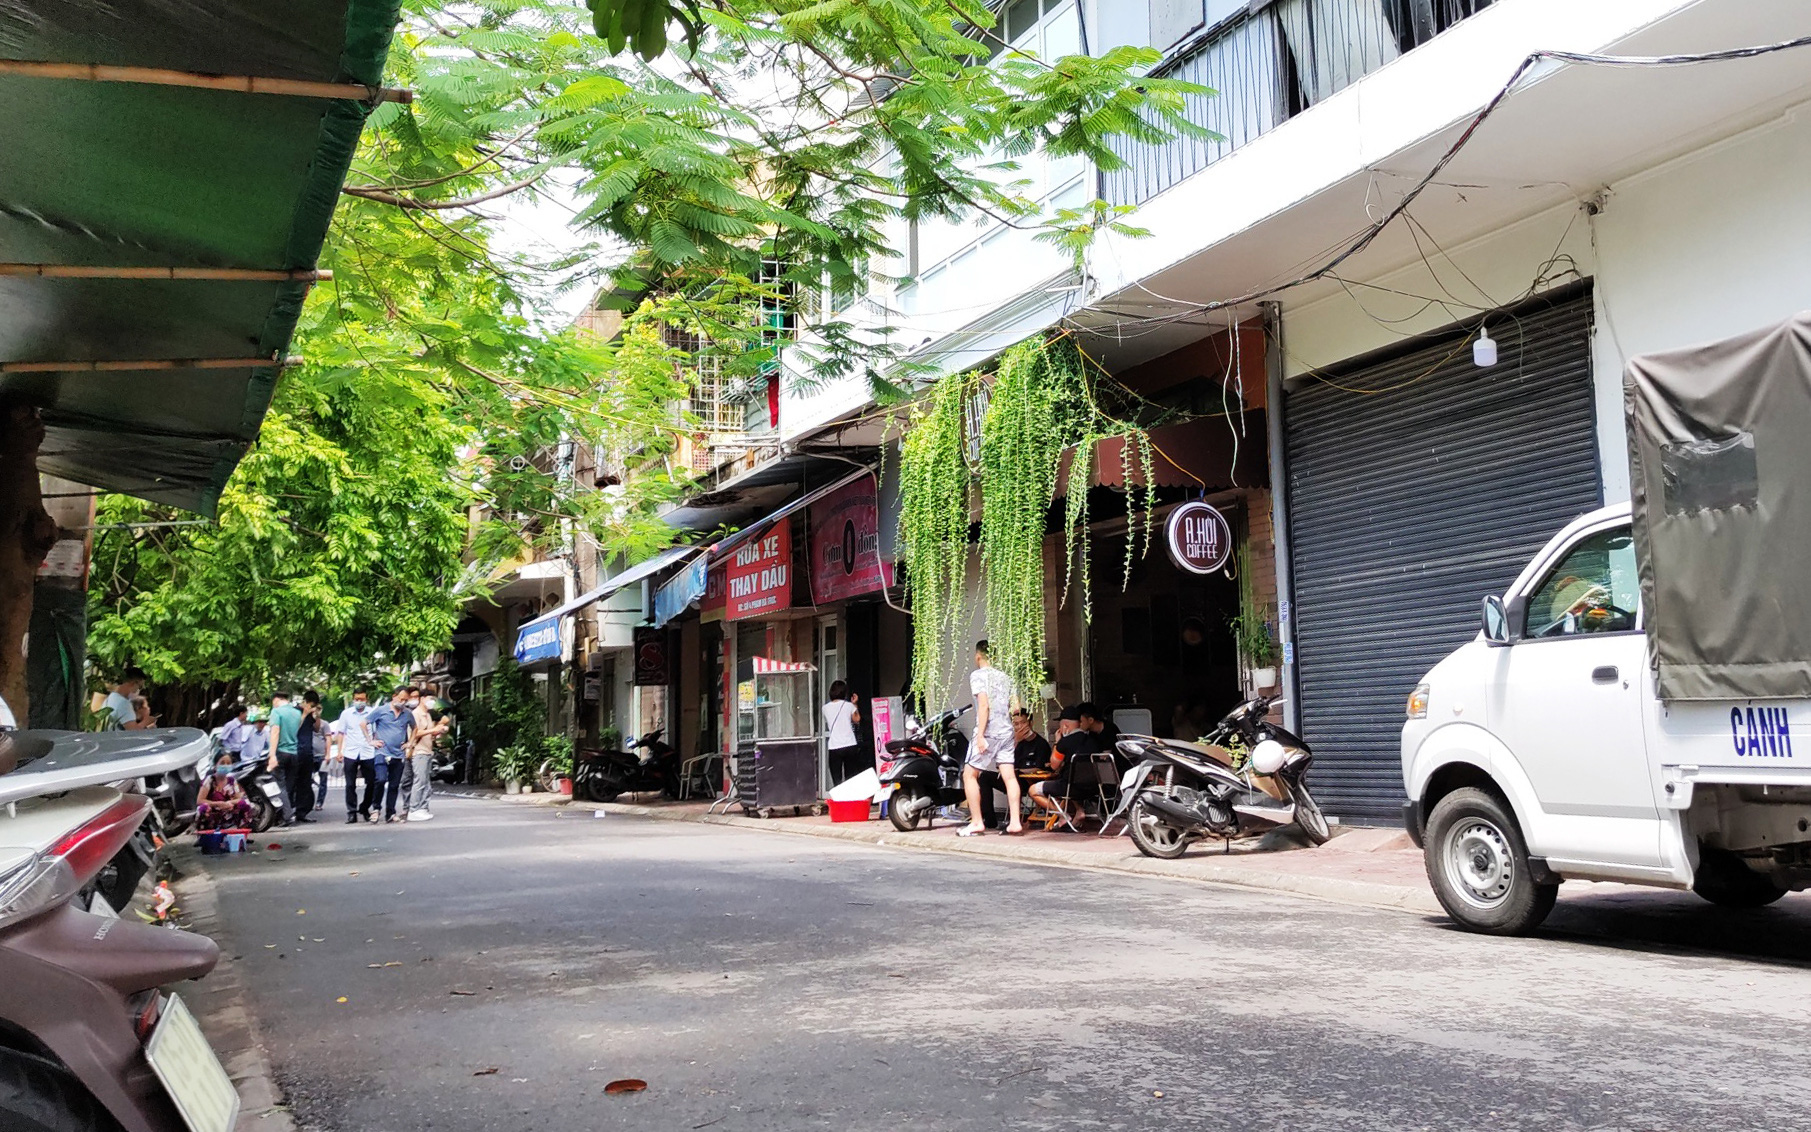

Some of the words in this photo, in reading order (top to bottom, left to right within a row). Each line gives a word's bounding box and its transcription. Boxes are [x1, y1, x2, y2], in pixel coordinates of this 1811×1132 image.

[763, 535, 779, 560] XE
[1186, 543, 1218, 559] COFFEE
[730, 572, 759, 599] THAY
